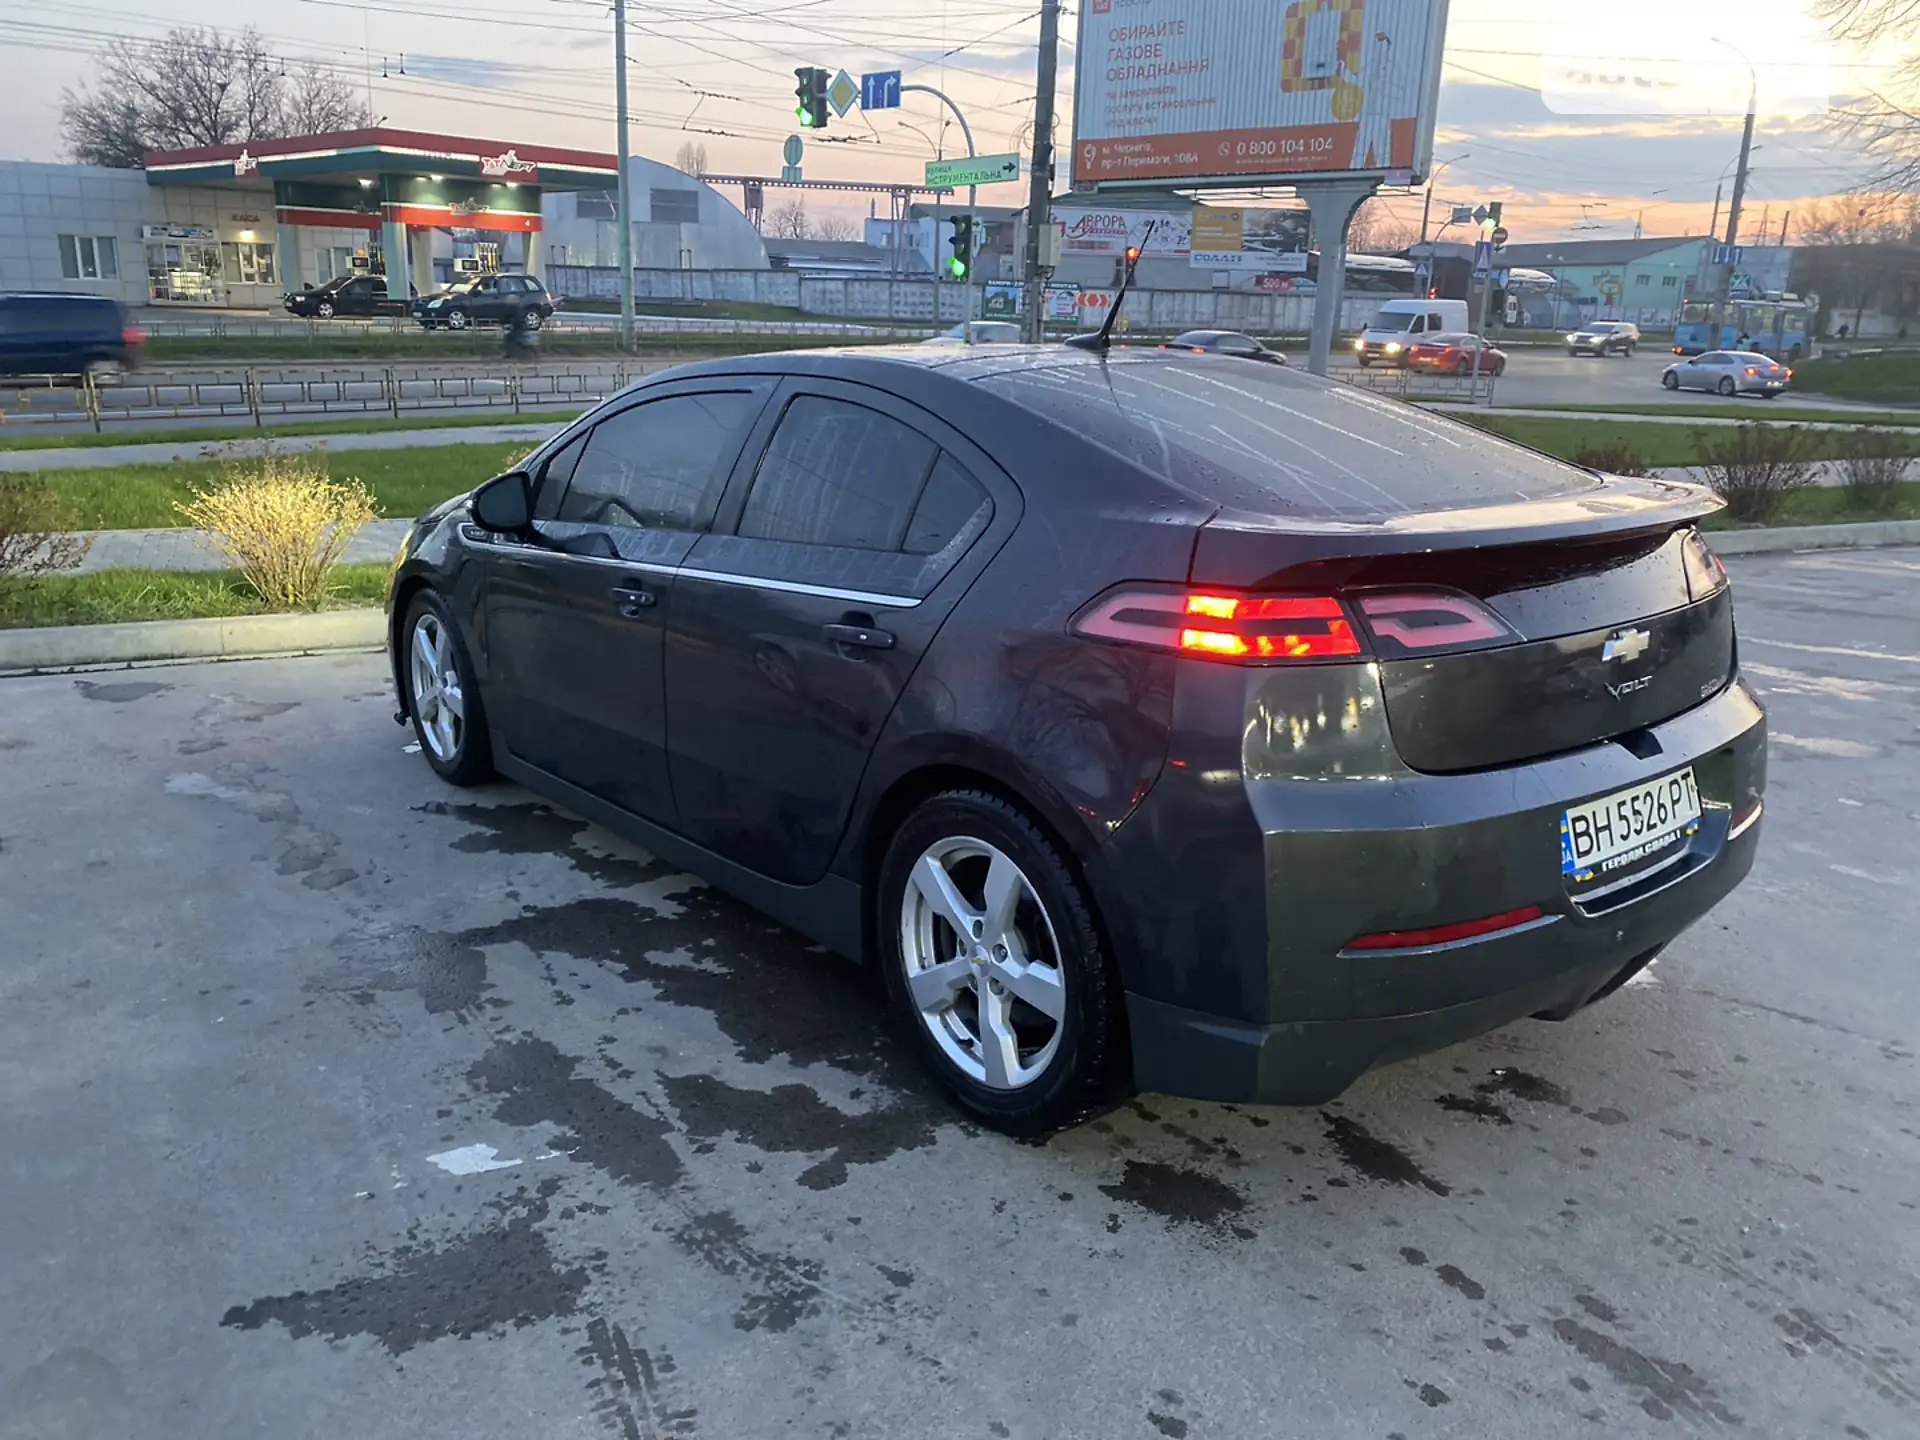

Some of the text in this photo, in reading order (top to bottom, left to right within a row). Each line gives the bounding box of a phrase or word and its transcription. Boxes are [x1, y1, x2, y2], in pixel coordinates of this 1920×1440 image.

[1108, 20, 1185, 42] ОБИРАЙТЕ
[1107, 43, 1163, 61] ГАЗОВЕ
[1106, 58, 1209, 81] ОБЛАДНАННЯ
[1237, 137, 1333, 155] 0 800 104 104
[1071, 214, 1127, 233] АВРОРА
[1263, 278, 1280, 289] 500
[1604, 676, 1652, 700] VOLT
